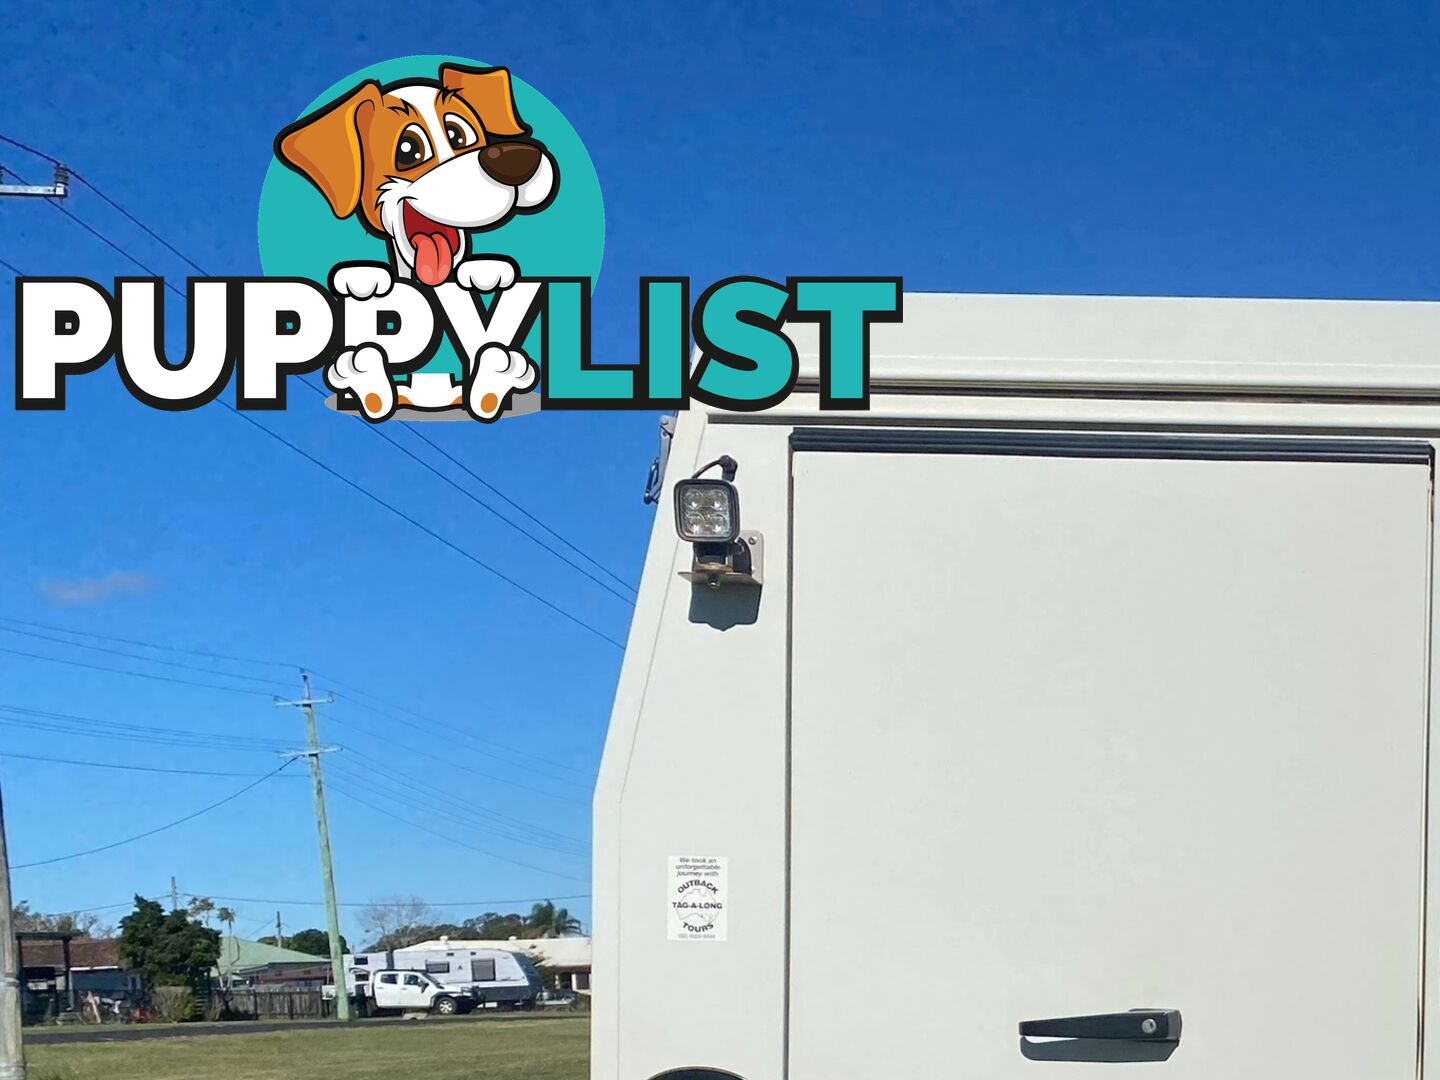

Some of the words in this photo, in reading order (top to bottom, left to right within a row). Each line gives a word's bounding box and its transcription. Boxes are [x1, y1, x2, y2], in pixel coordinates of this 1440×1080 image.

[677, 879, 718, 894] OUTBACK
[672, 901, 723, 909] TAG-A-LONG
[682, 922, 714, 933] TOURS
